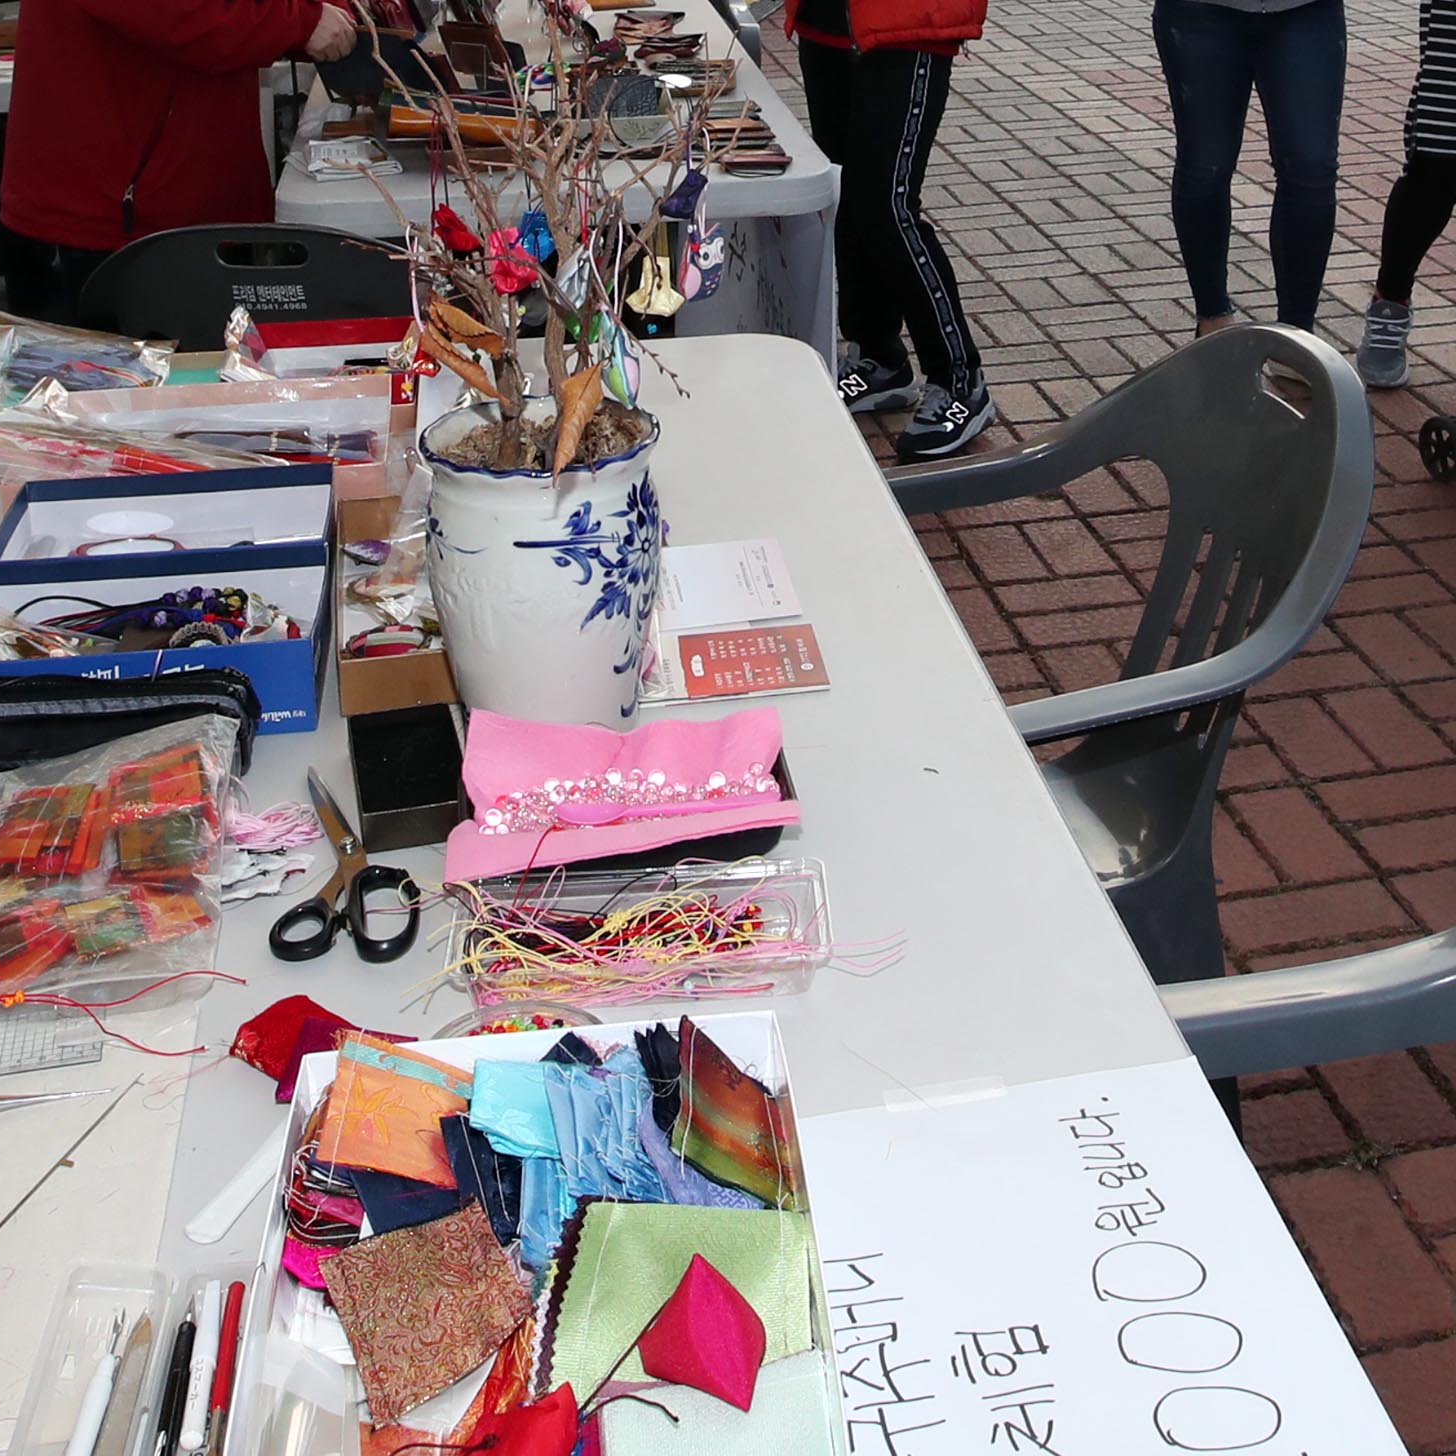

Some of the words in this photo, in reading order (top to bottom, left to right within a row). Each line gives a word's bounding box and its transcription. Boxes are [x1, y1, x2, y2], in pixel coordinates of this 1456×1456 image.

[839, 373, 868, 397] N
[945, 401, 970, 425] N
[950, 1322, 1056, 1456] 체험
